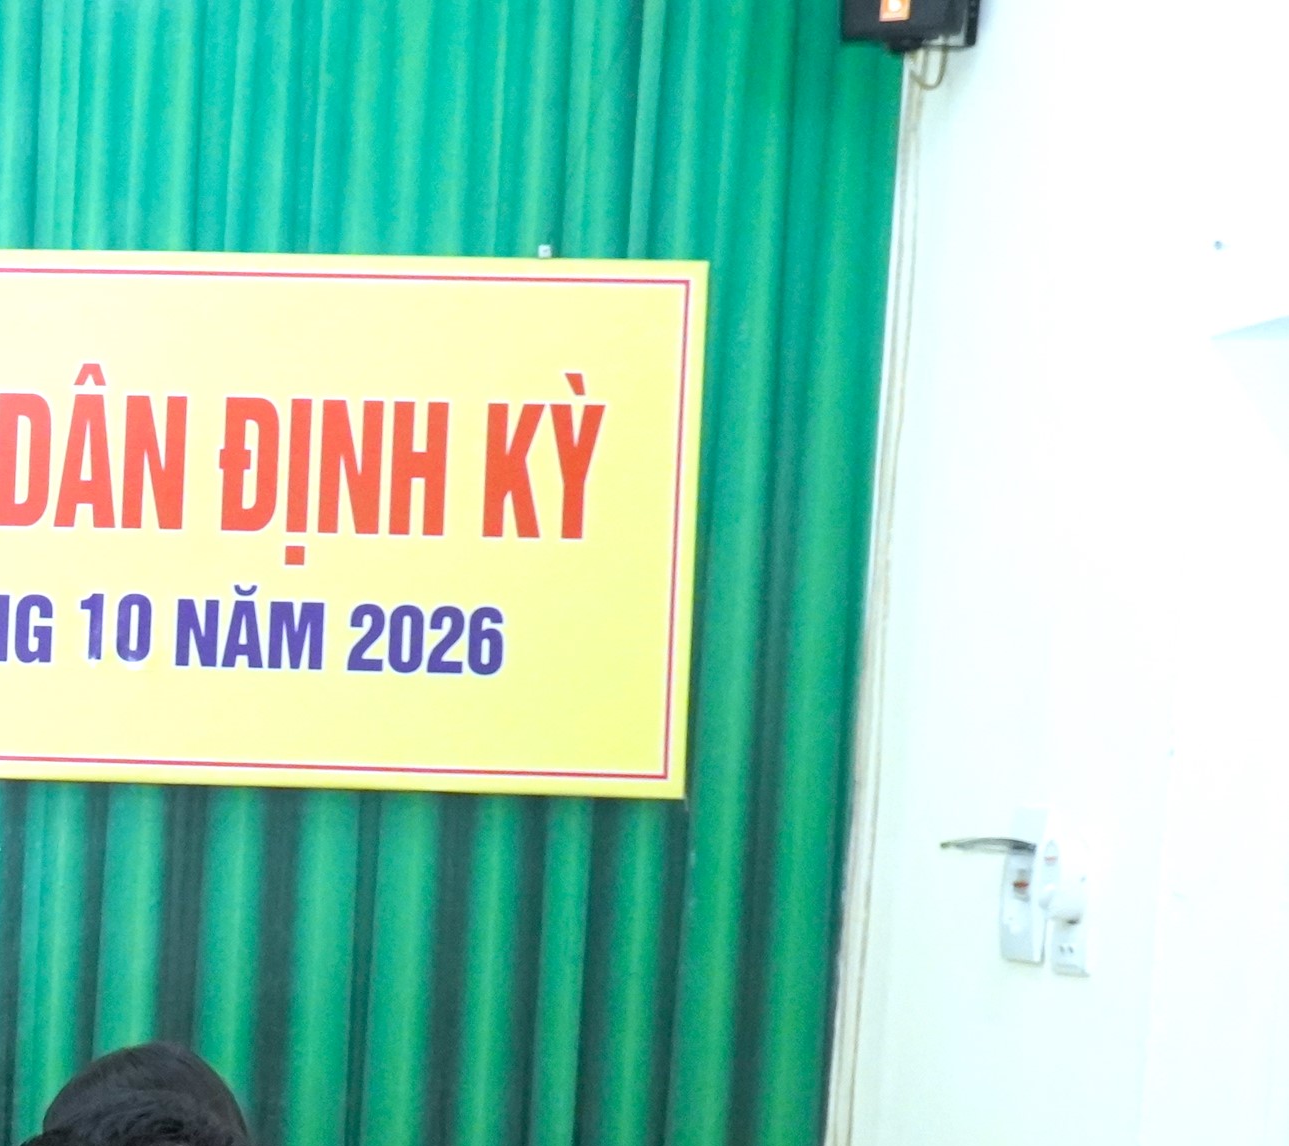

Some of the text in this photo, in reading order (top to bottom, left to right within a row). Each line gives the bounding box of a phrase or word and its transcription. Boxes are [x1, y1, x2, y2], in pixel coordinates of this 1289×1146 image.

[218, 395, 451, 566] ĐỊNH
[480, 372, 607, 541] KỲ
[79, 592, 153, 663] 10
[173, 583, 326, 672] NĂM
[346, 602, 505, 677] 2026
